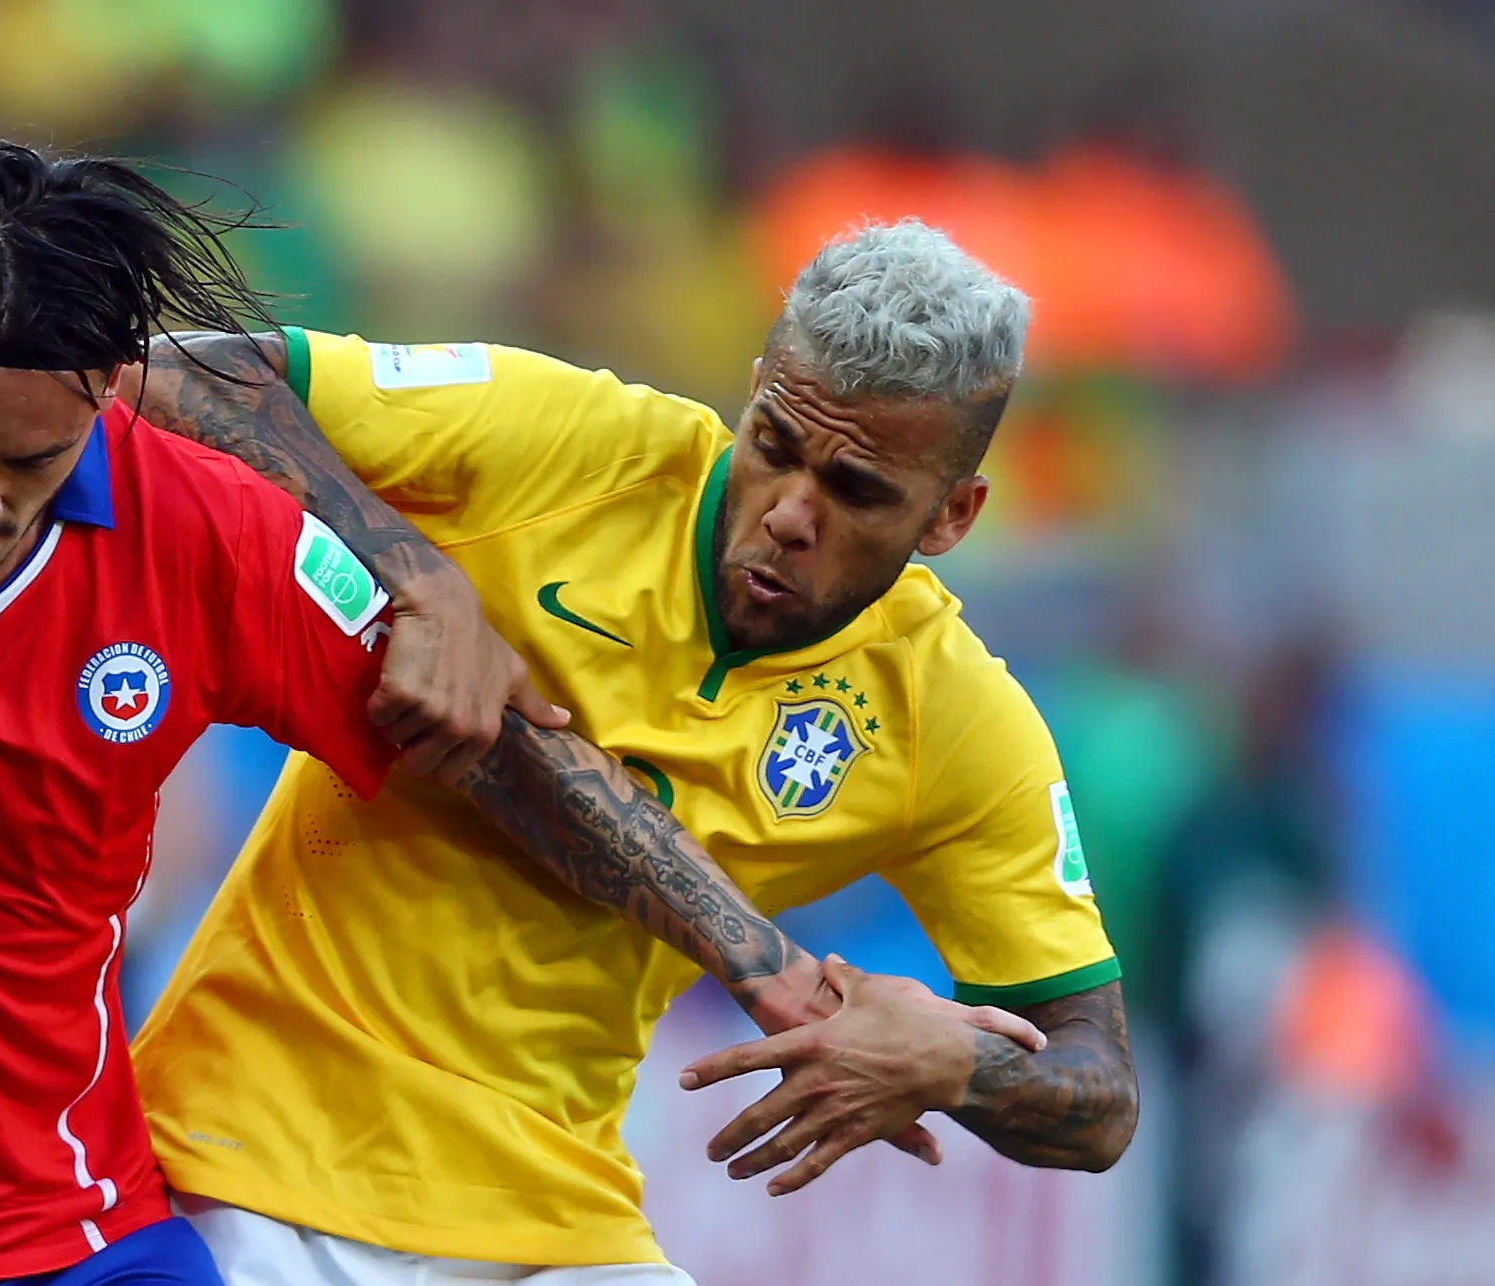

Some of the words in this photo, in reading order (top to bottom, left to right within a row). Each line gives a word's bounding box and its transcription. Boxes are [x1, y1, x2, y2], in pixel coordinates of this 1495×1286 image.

[78, 642, 129, 689] FEDERACION
[130, 643, 144, 656] DE
[143, 647, 169, 685] FUTBOL
[103, 728, 118, 743] DE
[119, 725, 149, 743] CHILE
[794, 744, 827, 767] CBF
